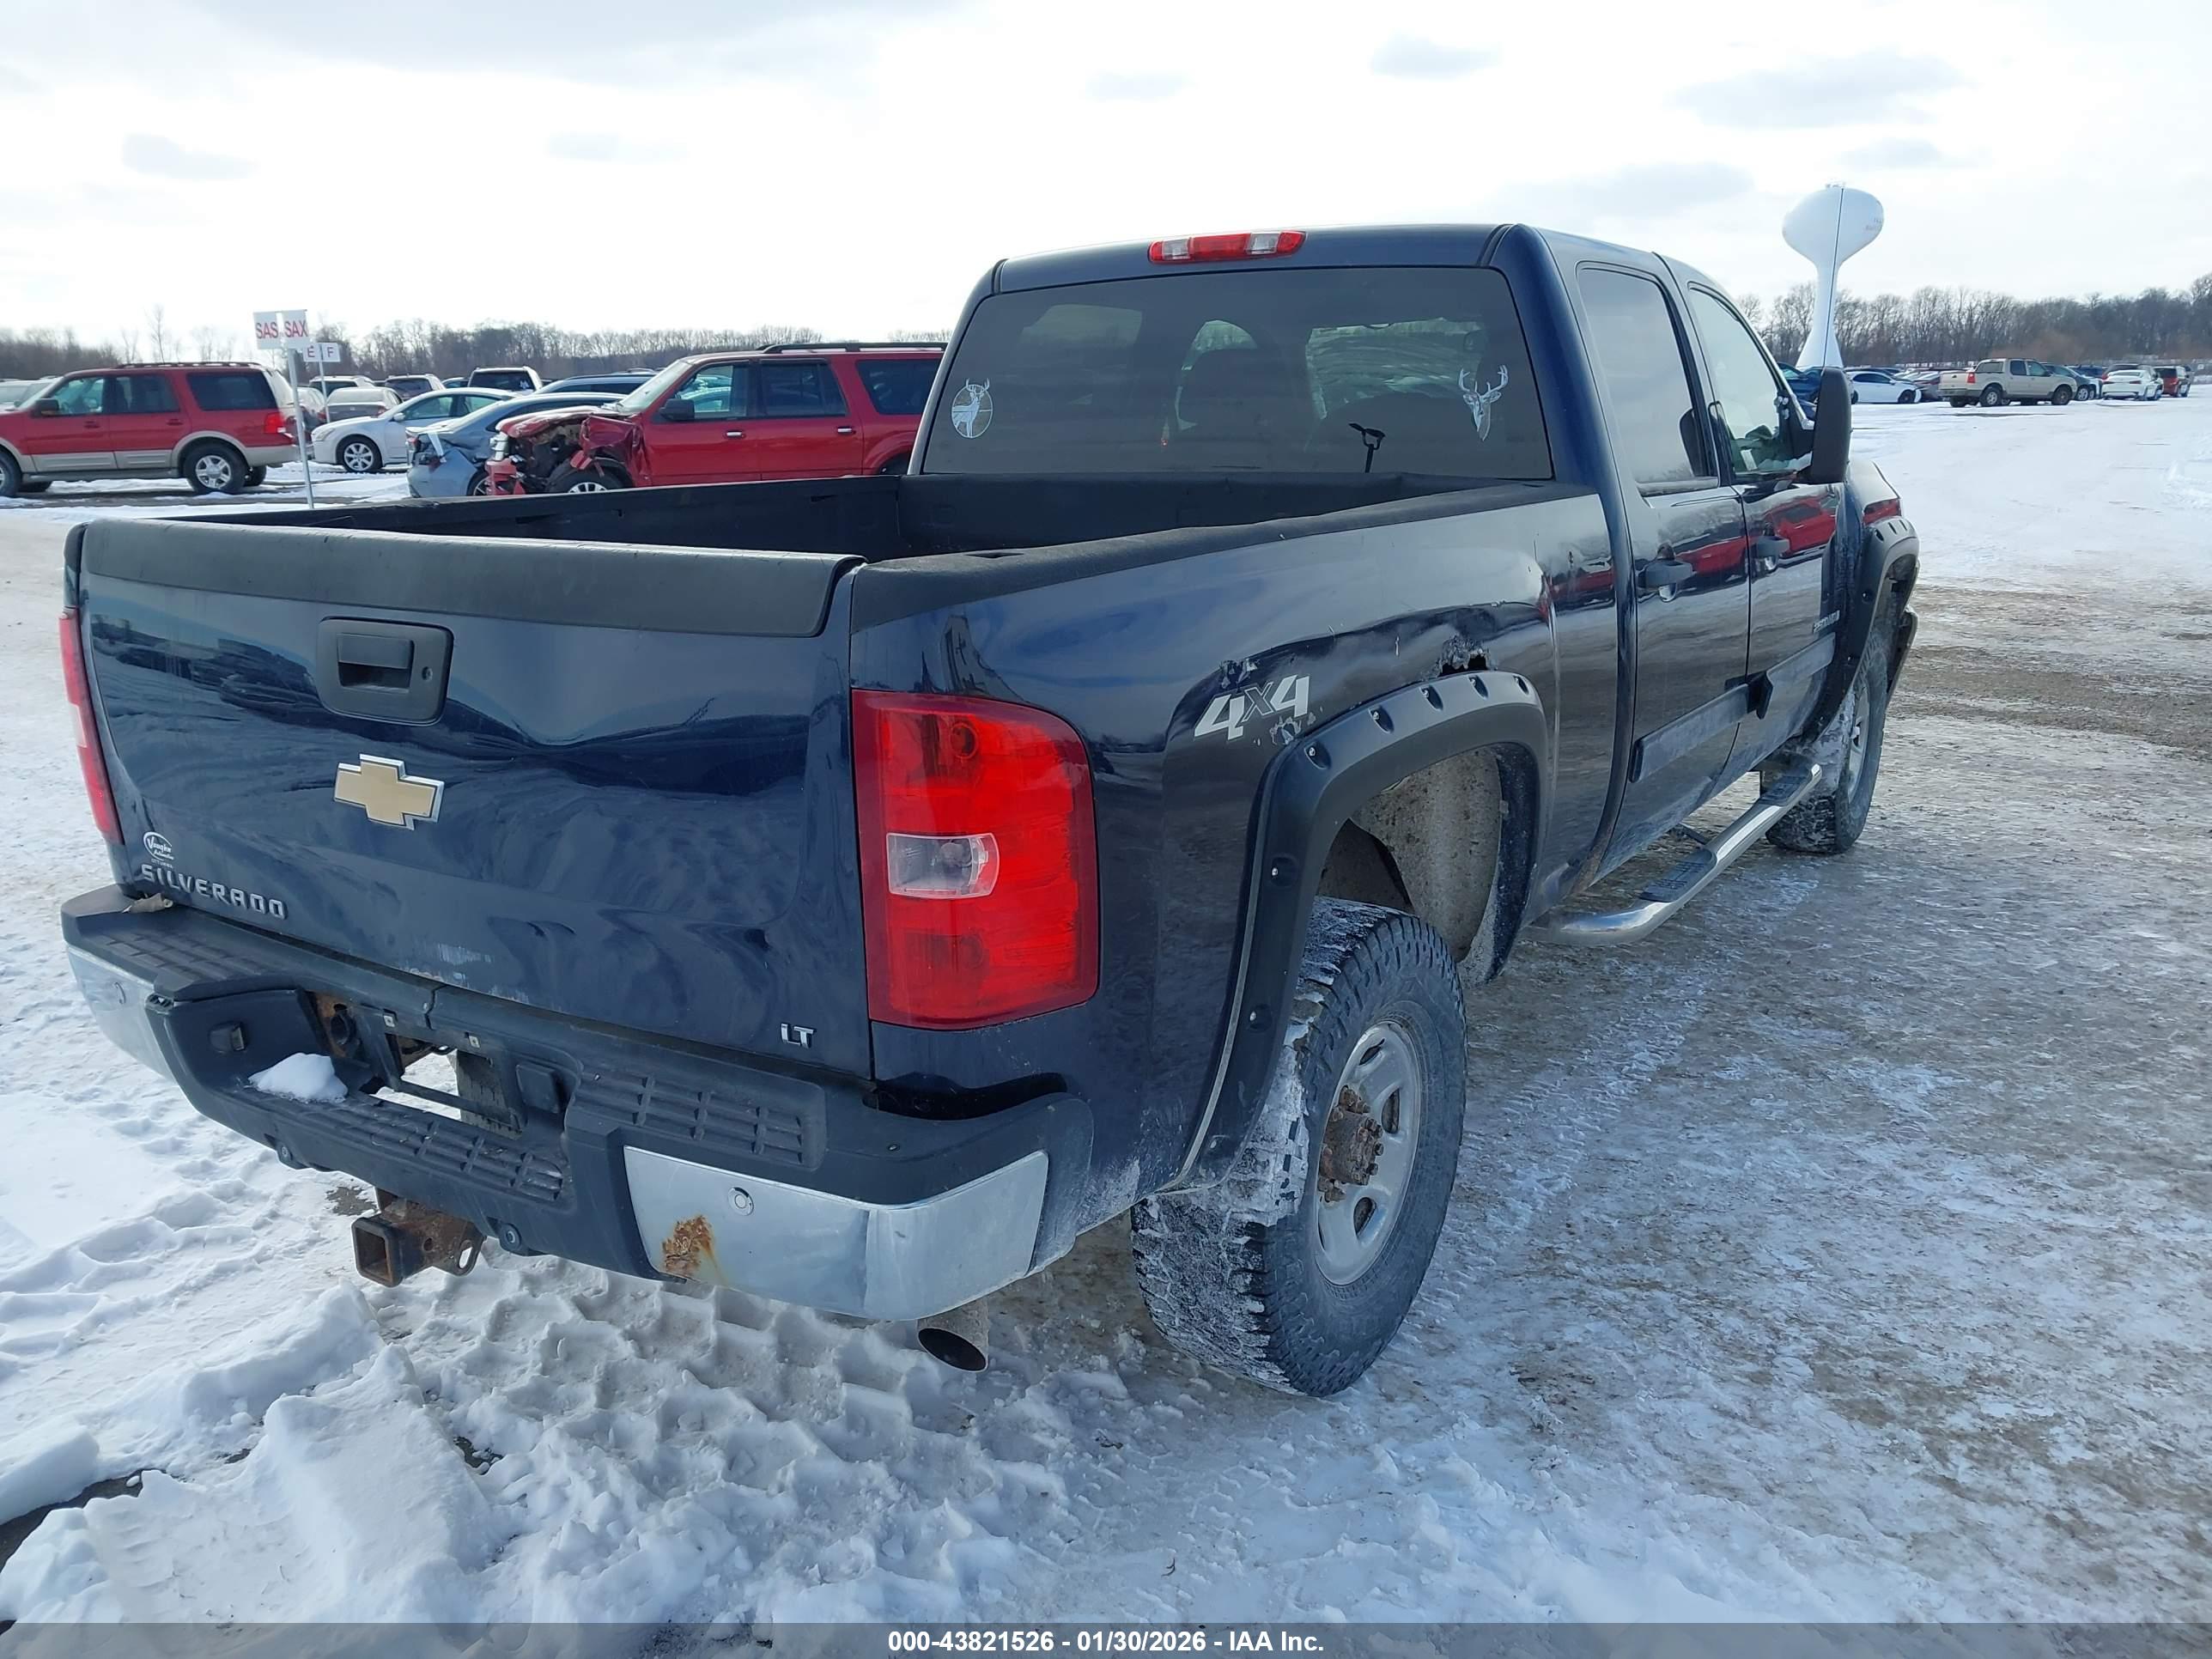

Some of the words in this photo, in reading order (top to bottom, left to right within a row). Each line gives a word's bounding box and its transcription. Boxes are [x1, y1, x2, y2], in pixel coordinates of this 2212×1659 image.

[256, 321, 279, 339] SAS
[283, 319, 309, 337] SAX
[326, 346, 335, 358] F
[141, 863, 289, 920] SILVERADO
[781, 1023, 815, 1049] LT
